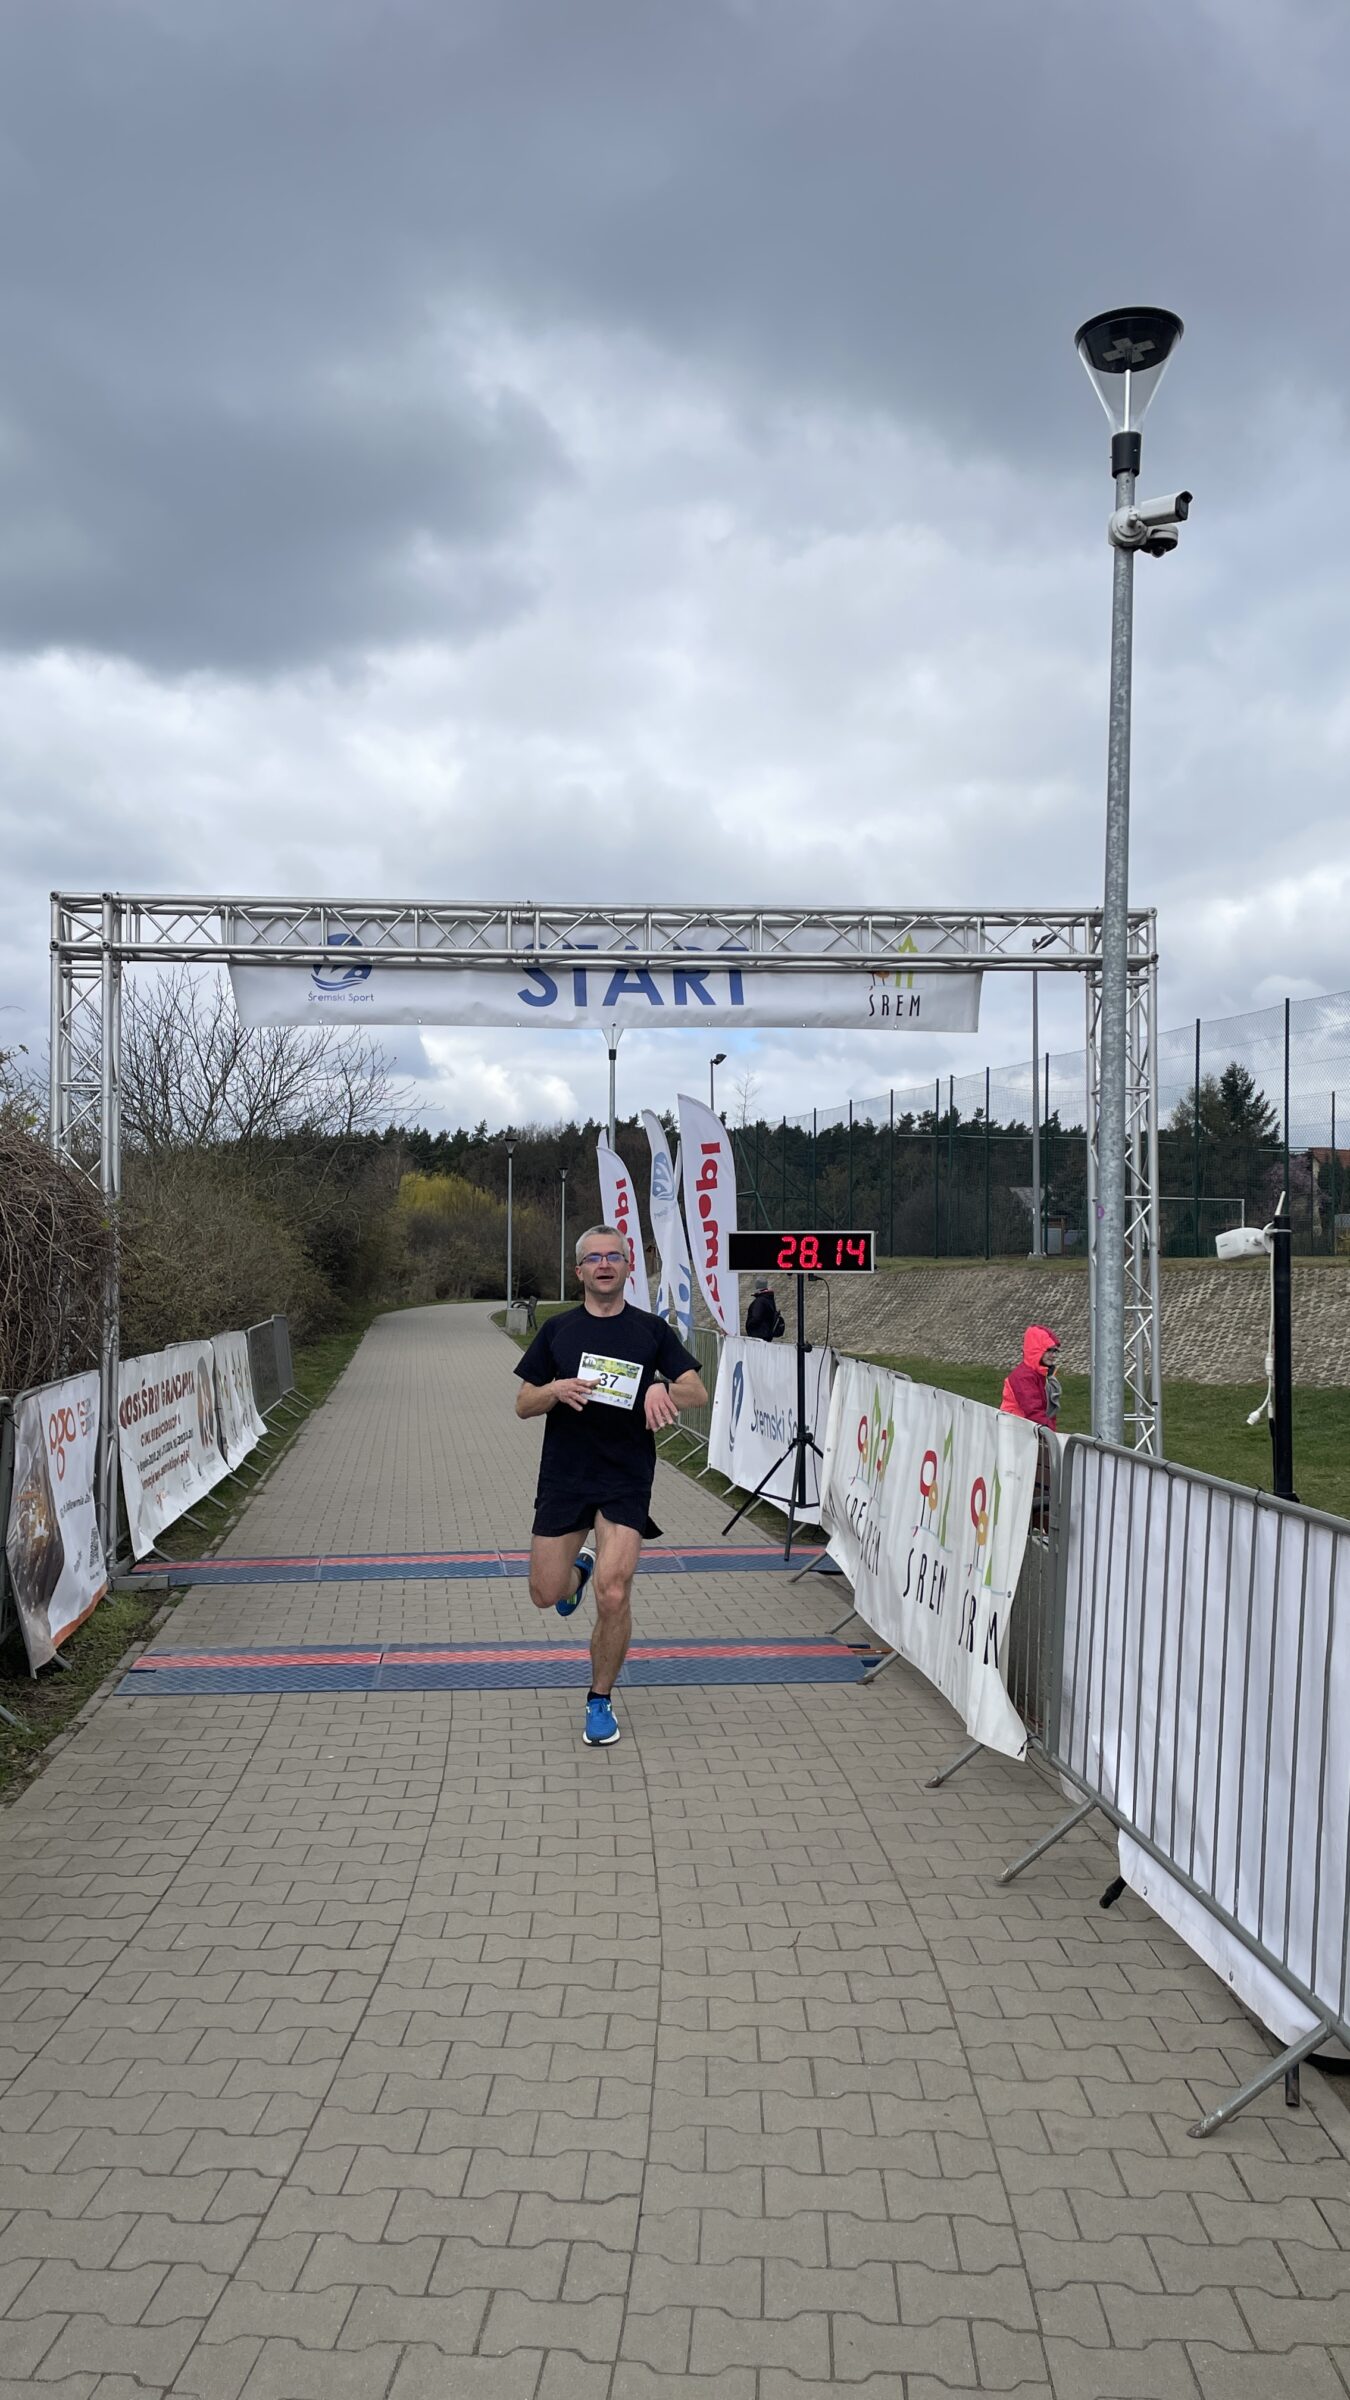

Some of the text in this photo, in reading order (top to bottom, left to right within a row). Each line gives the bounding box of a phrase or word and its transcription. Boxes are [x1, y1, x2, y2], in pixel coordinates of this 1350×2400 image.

[517, 943, 749, 1007] START
[308, 991, 374, 1003] Śremski Sport
[869, 985, 921, 1017] ŚREM
[599, 1373, 619, 1388] 37
